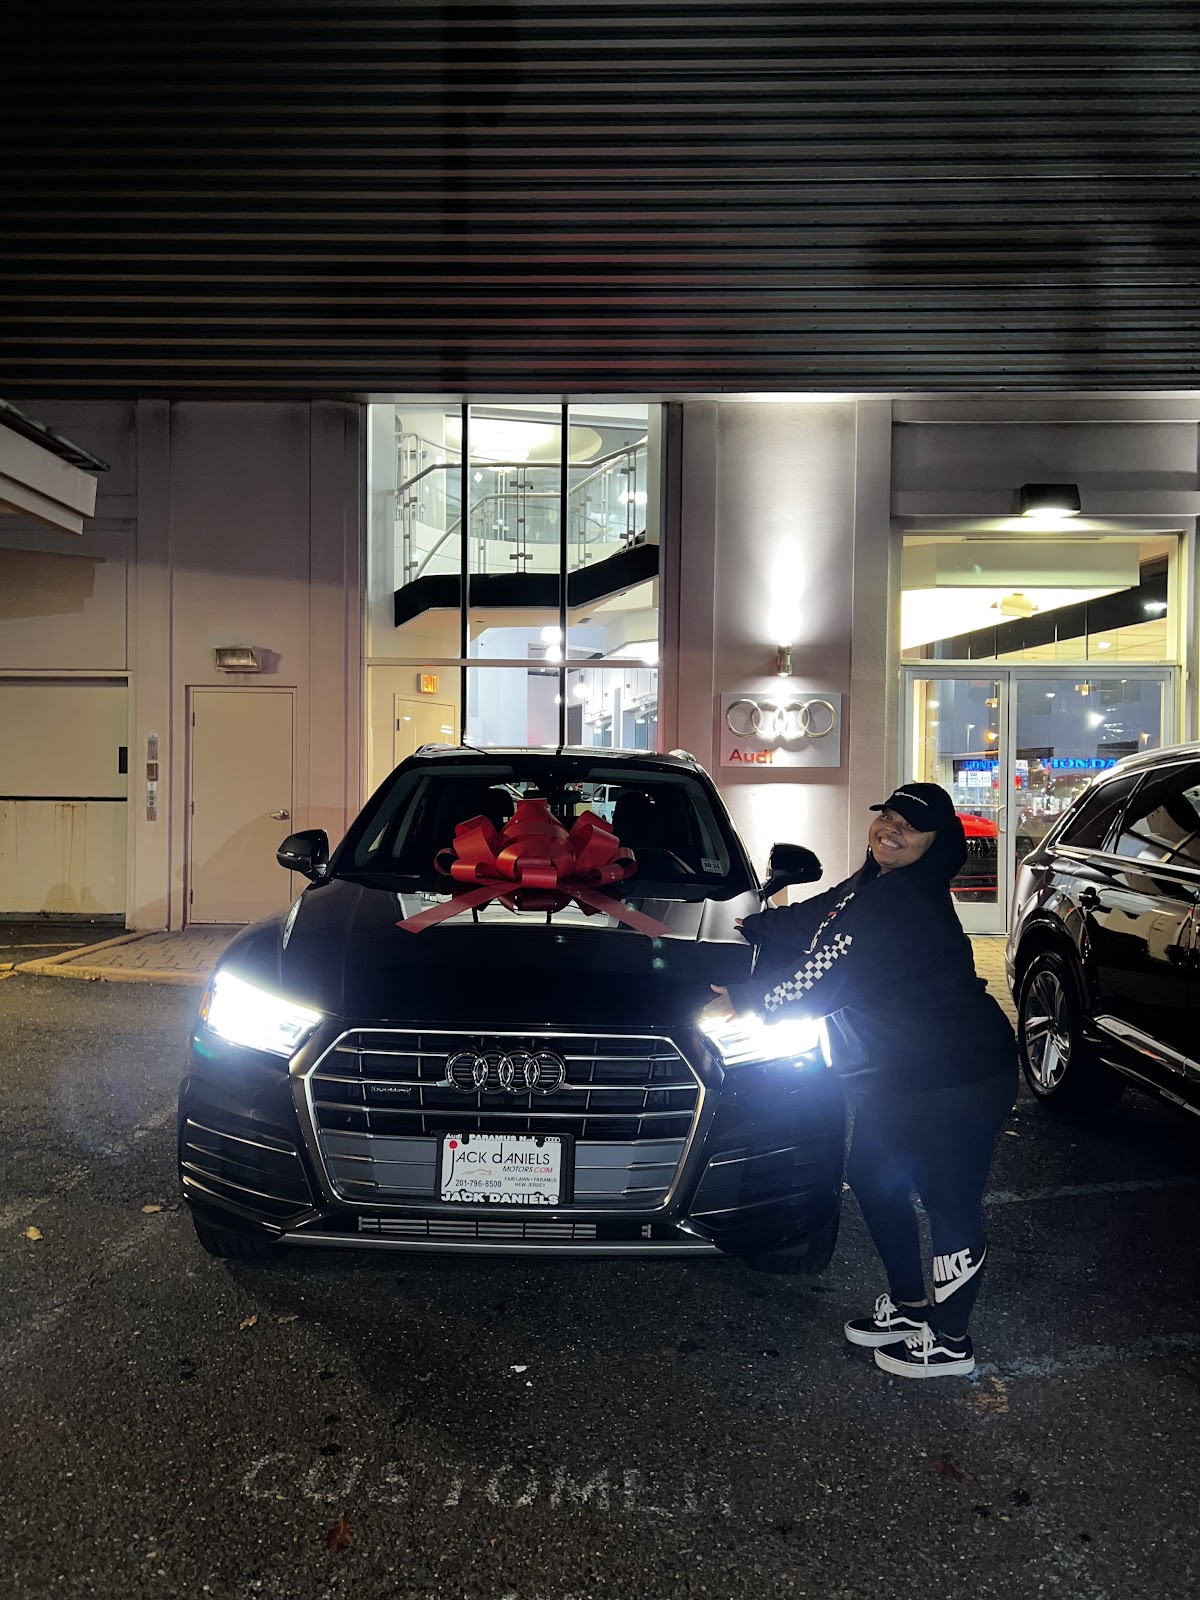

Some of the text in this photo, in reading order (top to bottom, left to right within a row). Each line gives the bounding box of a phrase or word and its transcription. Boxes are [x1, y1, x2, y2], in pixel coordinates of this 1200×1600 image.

[729, 748, 774, 764] Audi
[455, 1180, 502, 1188] 201-796-8500
[441, 1191, 559, 1205] JACK DANIELS
